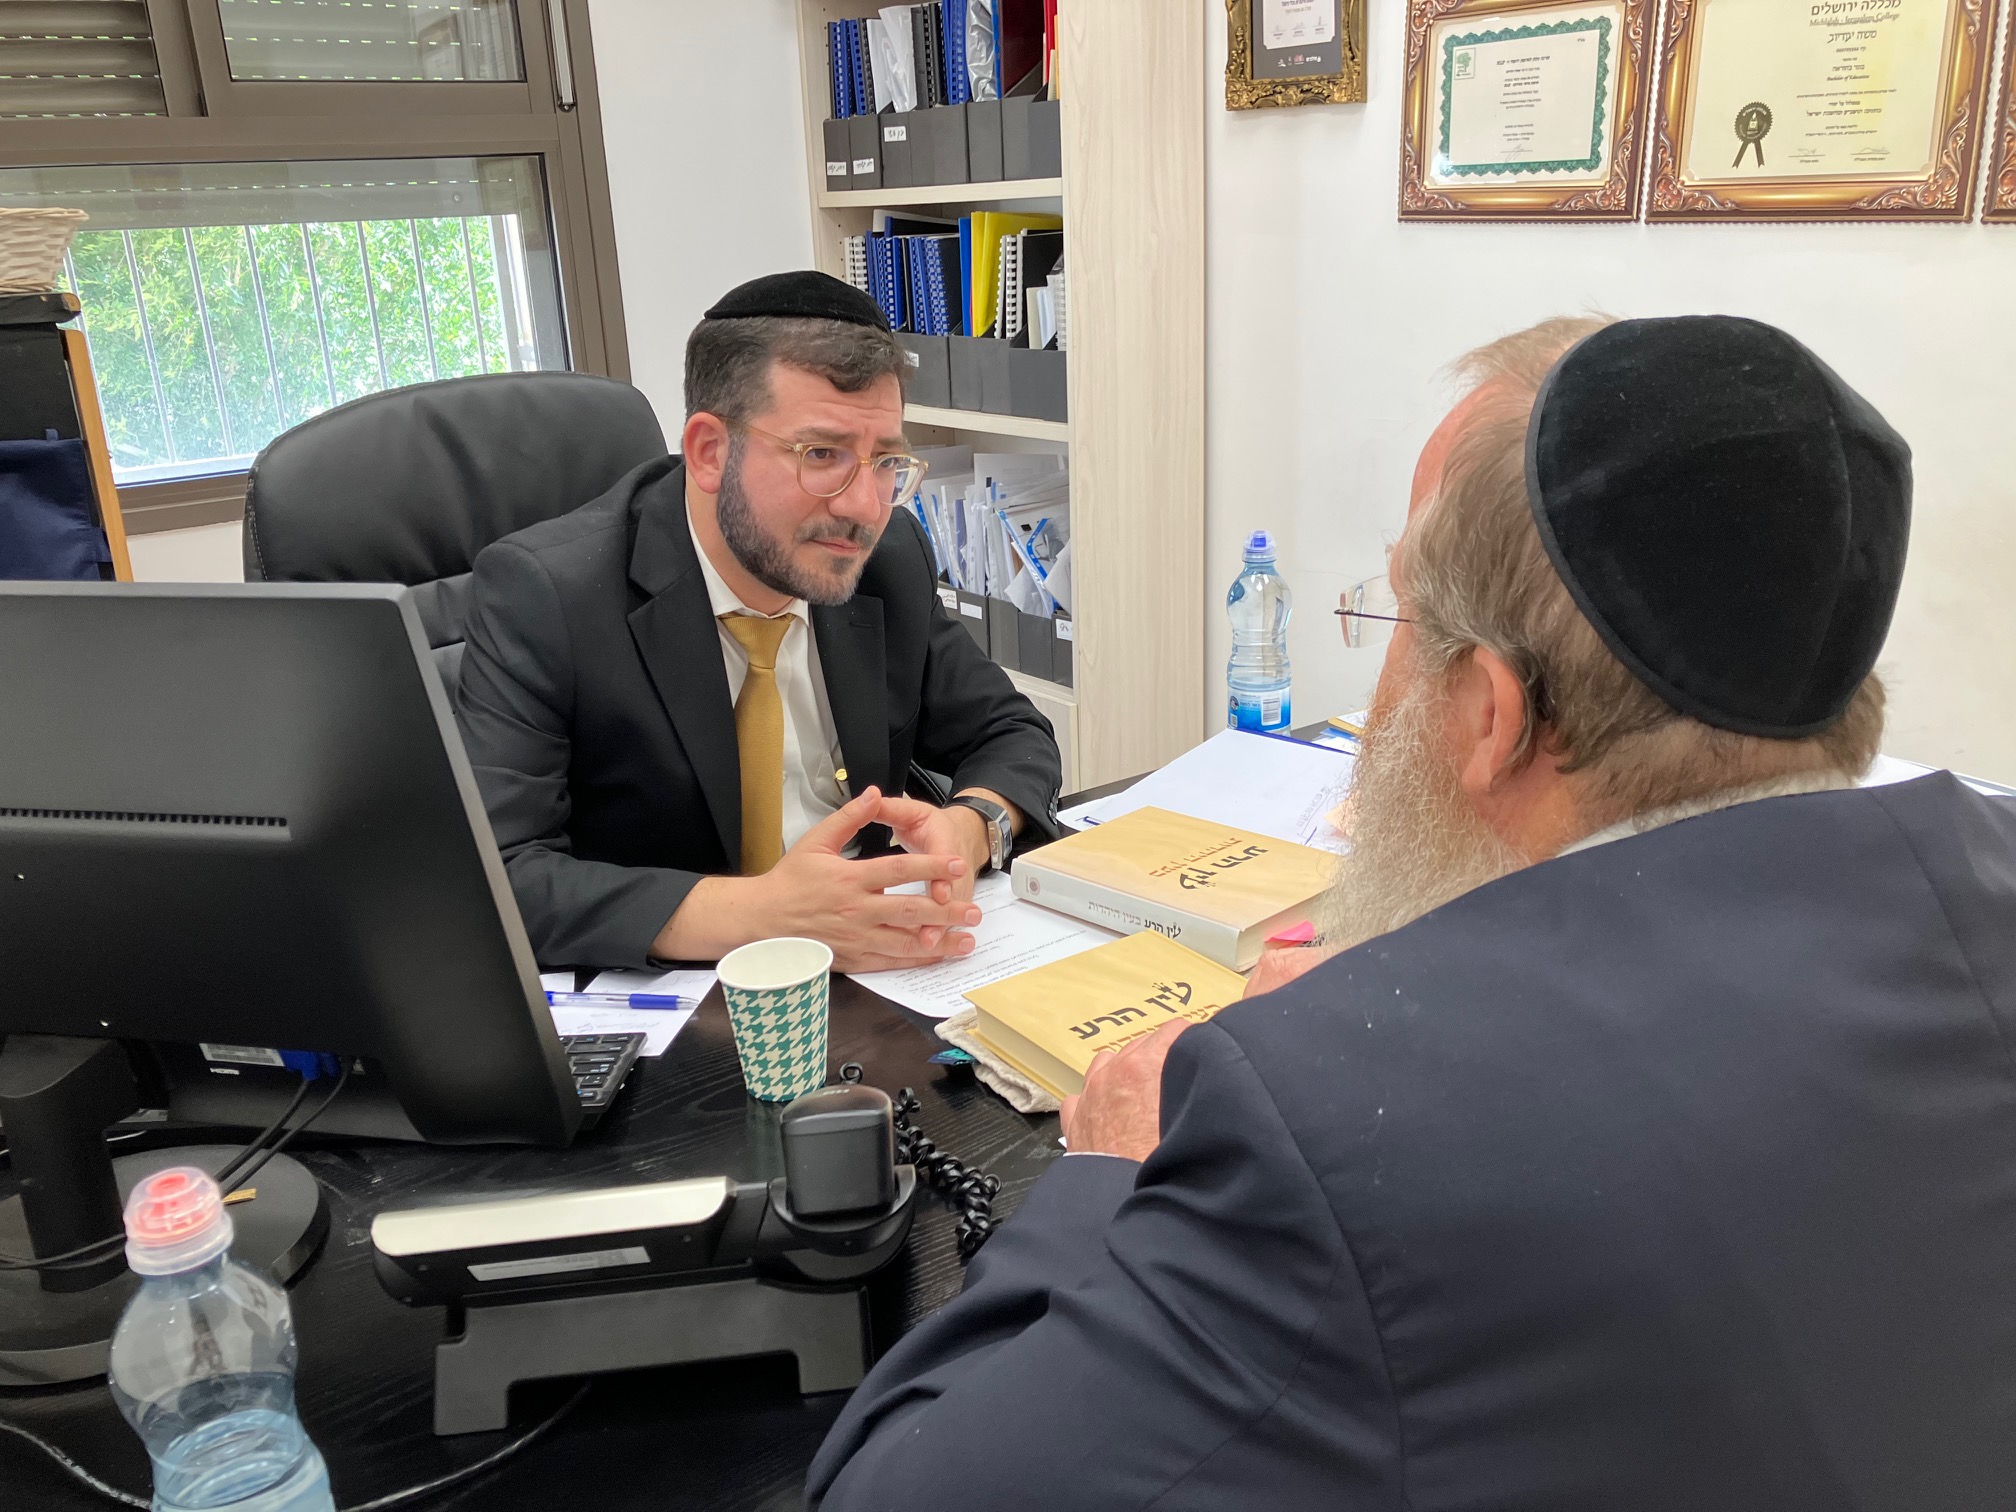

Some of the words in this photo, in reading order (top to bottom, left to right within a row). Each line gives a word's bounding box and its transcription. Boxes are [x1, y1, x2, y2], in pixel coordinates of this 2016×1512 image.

[1811, 1, 1857, 16] ירושלים
[1861, 0, 1901, 11] מכללה
[1874, 12, 1900, 22] College
[1179, 867, 1217, 890] עין
[1210, 846, 1269, 868] הרע
[1088, 900, 1120, 919] היהדות
[1122, 911, 1142, 926] בעין
[1144, 919, 1164, 934] הרע
[1166, 921, 1182, 939] עין
[1144, 981, 1192, 1014] עין
[1176, 1004, 1222, 1020] בעי
[1069, 1007, 1149, 1040] הרע
